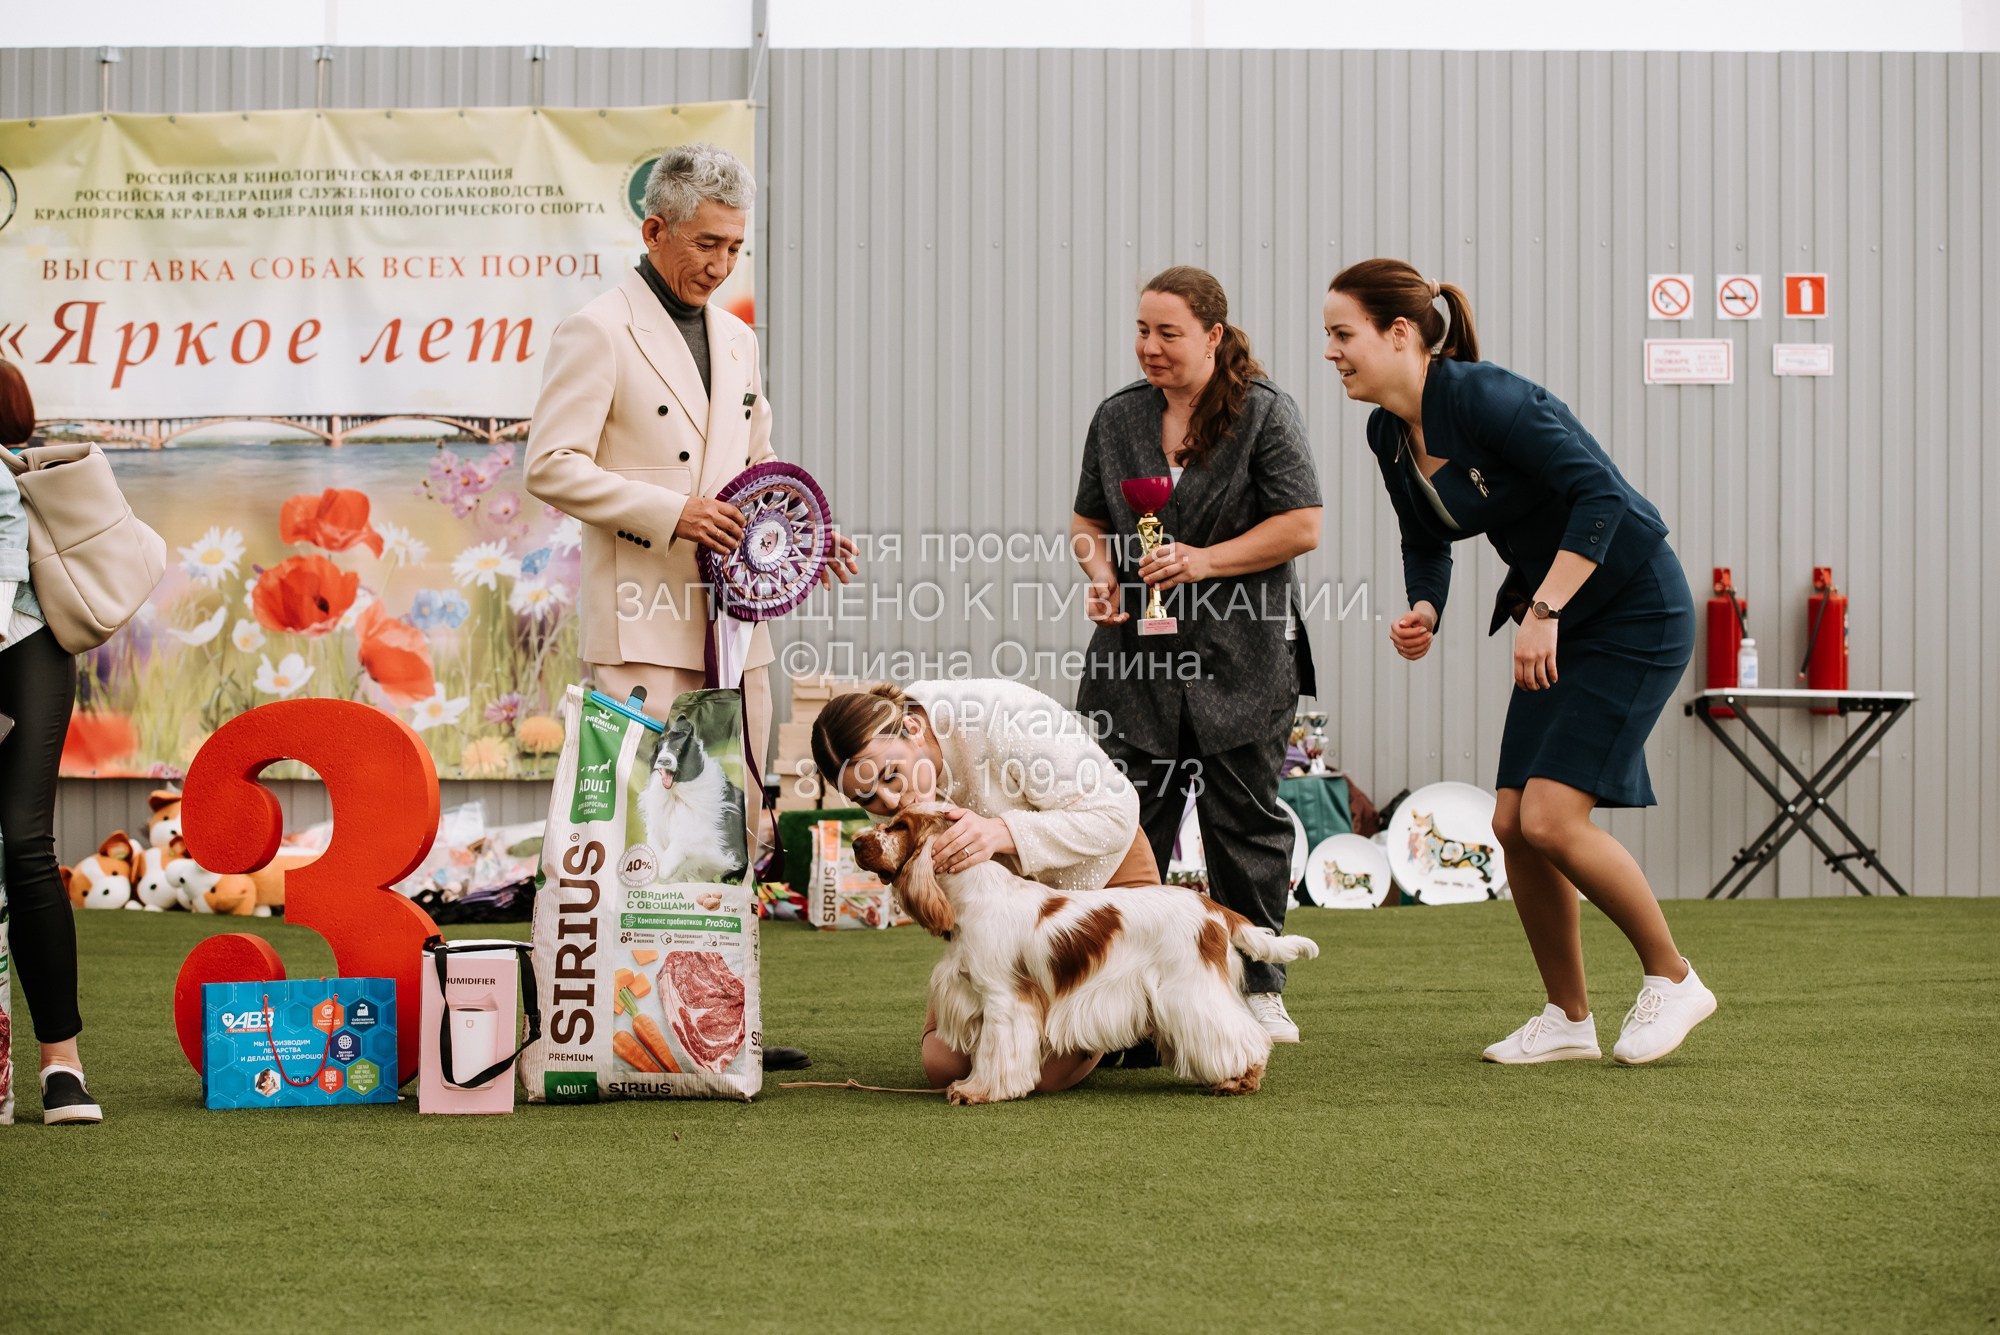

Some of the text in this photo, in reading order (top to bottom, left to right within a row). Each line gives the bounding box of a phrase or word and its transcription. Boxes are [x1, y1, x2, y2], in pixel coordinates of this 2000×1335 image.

[126, 167, 514, 185] РОССИЙСКАЯ КИНОЛОГИЧЕСКАЯ ФЕДЕРАЦИЯ
[74, 185, 565, 204] РОССИЙСКАЯ ФЕДЕРАЦИЯ СЛУЖЕБНОГО СОБАКОВОДСТВА
[34, 202, 606, 220] КРАСНОЯРСКАЯ КРАЕВАЯ ФЕДЕРАЦИЯ КИНОЛОГИЧЕСКОГО СПОРТА
[42, 254, 603, 282] ВЫСТАВКА СОБАК ВСЕХ ПОРОД
[360, 317, 562, 364] лет
[585, 715, 620, 733] PREMIUM
[579, 778, 612, 793] ADULT
[625, 858, 652, 872] 40%
[174, 697, 441, 1086] 3
[627, 890, 685, 901] ГОВЯДИНА
[823, 866, 837, 923] SIRIUS
[626, 900, 695, 911] С ОВОЩАМИ
[637, 917, 666, 925] Комплекс
[704, 918, 739, 928] ProStor+
[550, 840, 606, 1046] SIRIUS
[548, 1053, 594, 1061] PREMIUM
[556, 1084, 588, 1095] ADULT
[608, 1082, 672, 1094] SIRIUS
